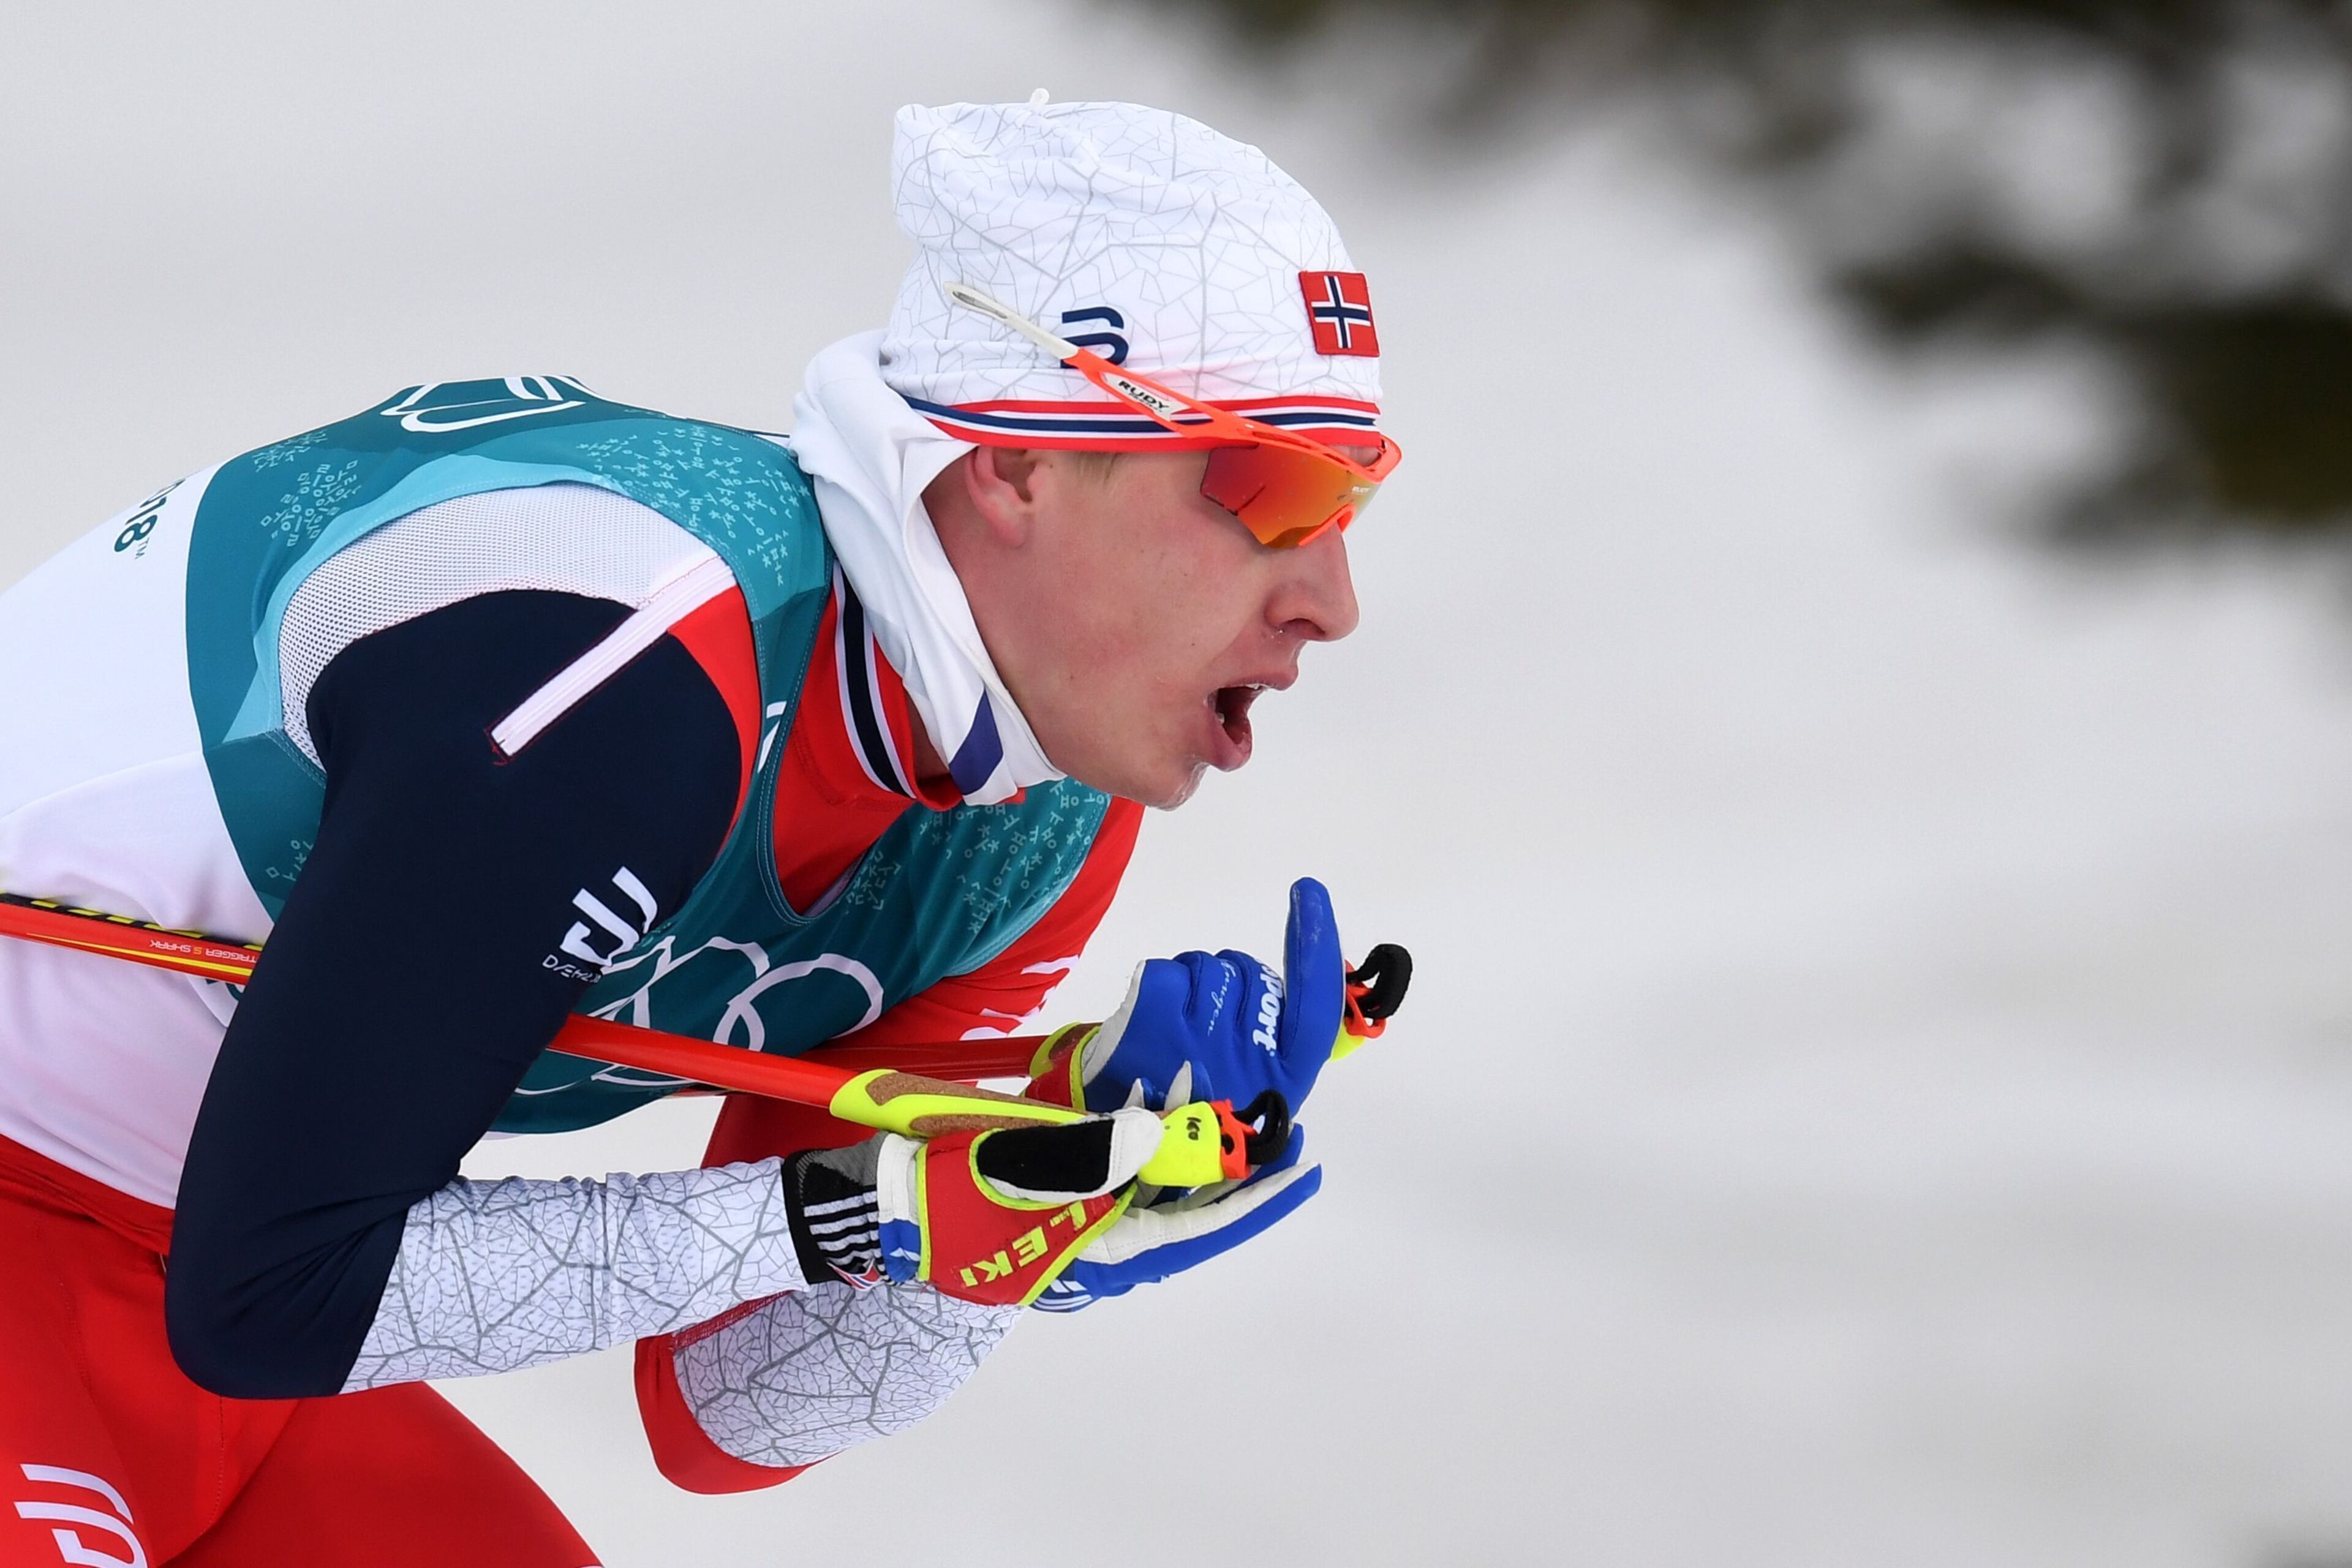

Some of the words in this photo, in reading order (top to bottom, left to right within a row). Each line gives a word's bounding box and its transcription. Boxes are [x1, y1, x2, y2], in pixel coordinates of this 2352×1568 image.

[1118, 380, 1170, 409] RUDY
[149, 938, 192, 954] SHARK
[192, 946, 203, 956] S
[205, 948, 259, 963] TRIGGER
[959, 1199, 1087, 1287] LEKI
